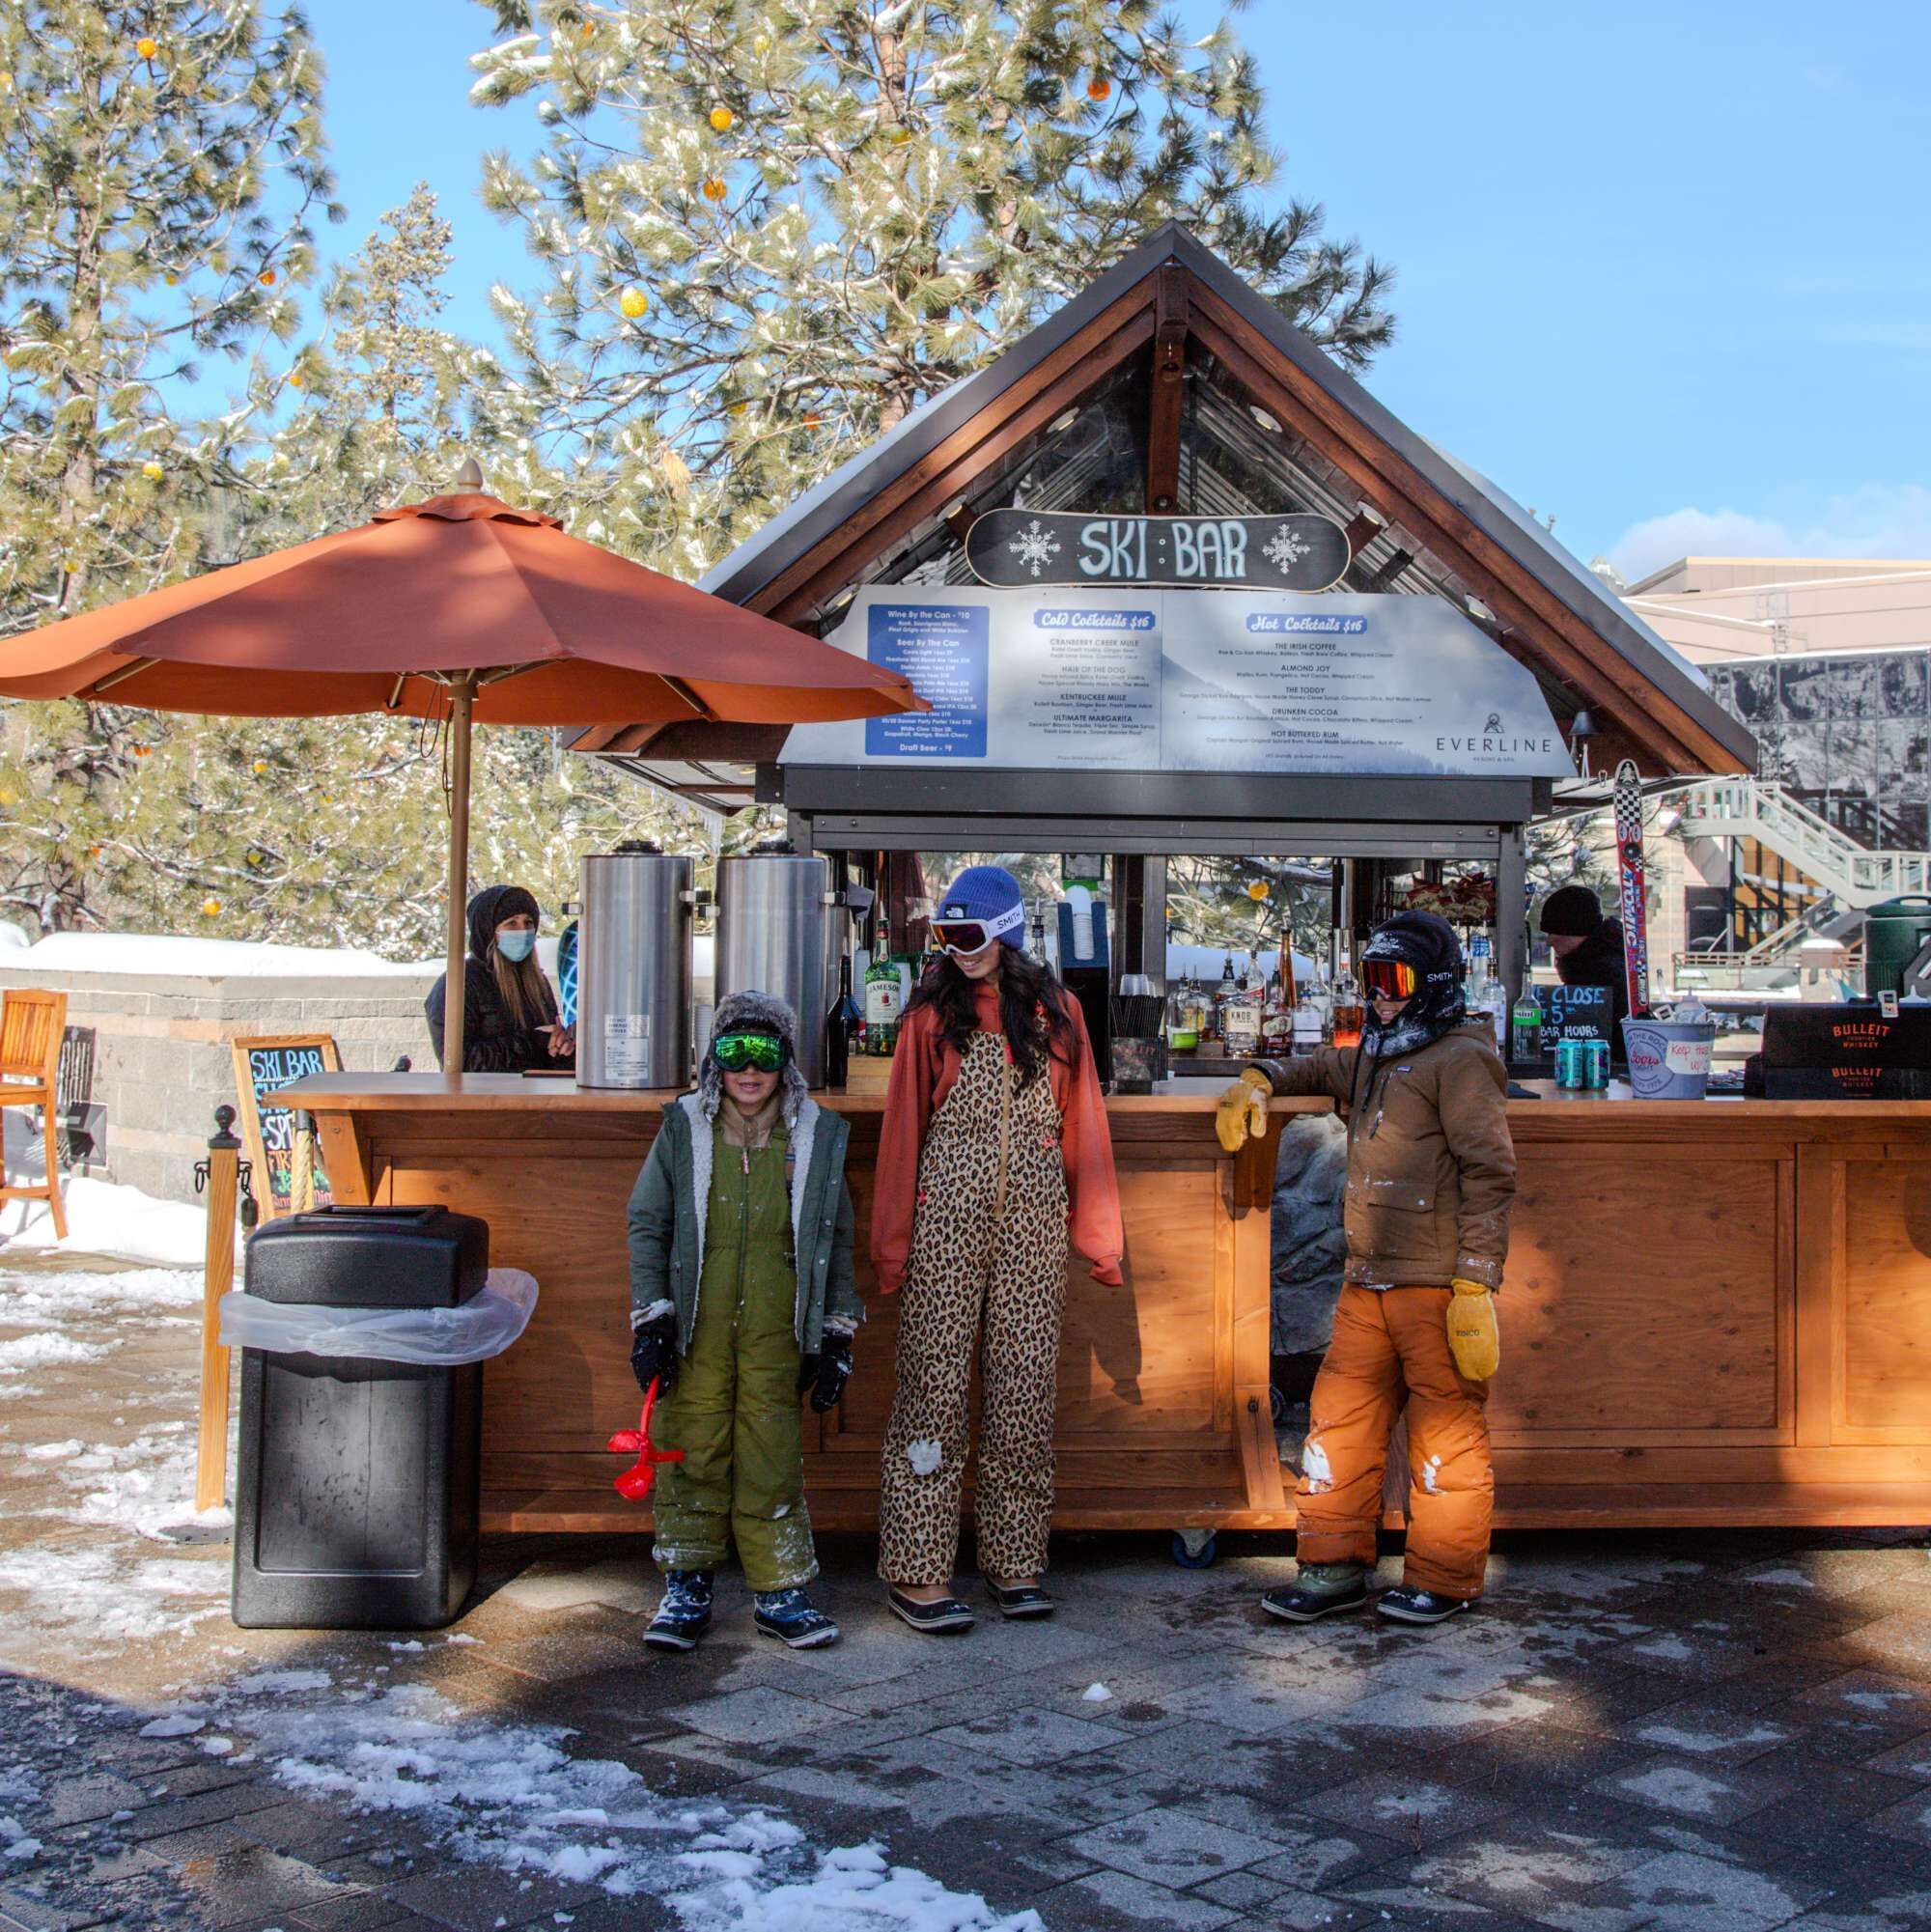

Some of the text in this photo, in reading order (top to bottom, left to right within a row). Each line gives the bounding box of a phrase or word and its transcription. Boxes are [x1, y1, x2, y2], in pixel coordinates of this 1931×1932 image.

[1078, 519, 1247, 578] SKI BAR
[888, 610, 907, 619] Wine
[909, 611, 918, 621] By
[920, 610, 933, 619] the
[934, 610, 951, 619] Can
[1042, 612, 1149, 630] Cold Cocktails $16
[1250, 615, 1362, 633] Hot Cocktails $16
[916, 640, 926, 649] By
[1120, 639, 1139, 648] MULE
[1437, 738, 1552, 752] EVERLINE
[1621, 864, 1638, 947] ATOMIC
[996, 910, 1021, 930] SMITH
[1427, 972, 1453, 983] SMITH
[868, 984, 901, 994] JAMESON
[1552, 986, 1607, 1004] CLOSE
[1231, 1012, 1252, 1021] KNOB
[1552, 1006, 1564, 1023] 5
[1540, 1025, 1599, 1038] BAR HOURS
[1833, 1023, 1890, 1037] BULLEIT
[250, 1050, 324, 1079] SKI BAR
[1631, 1050, 1660, 1066] Coors
[1831, 1066, 1883, 1078] BULLEIT
